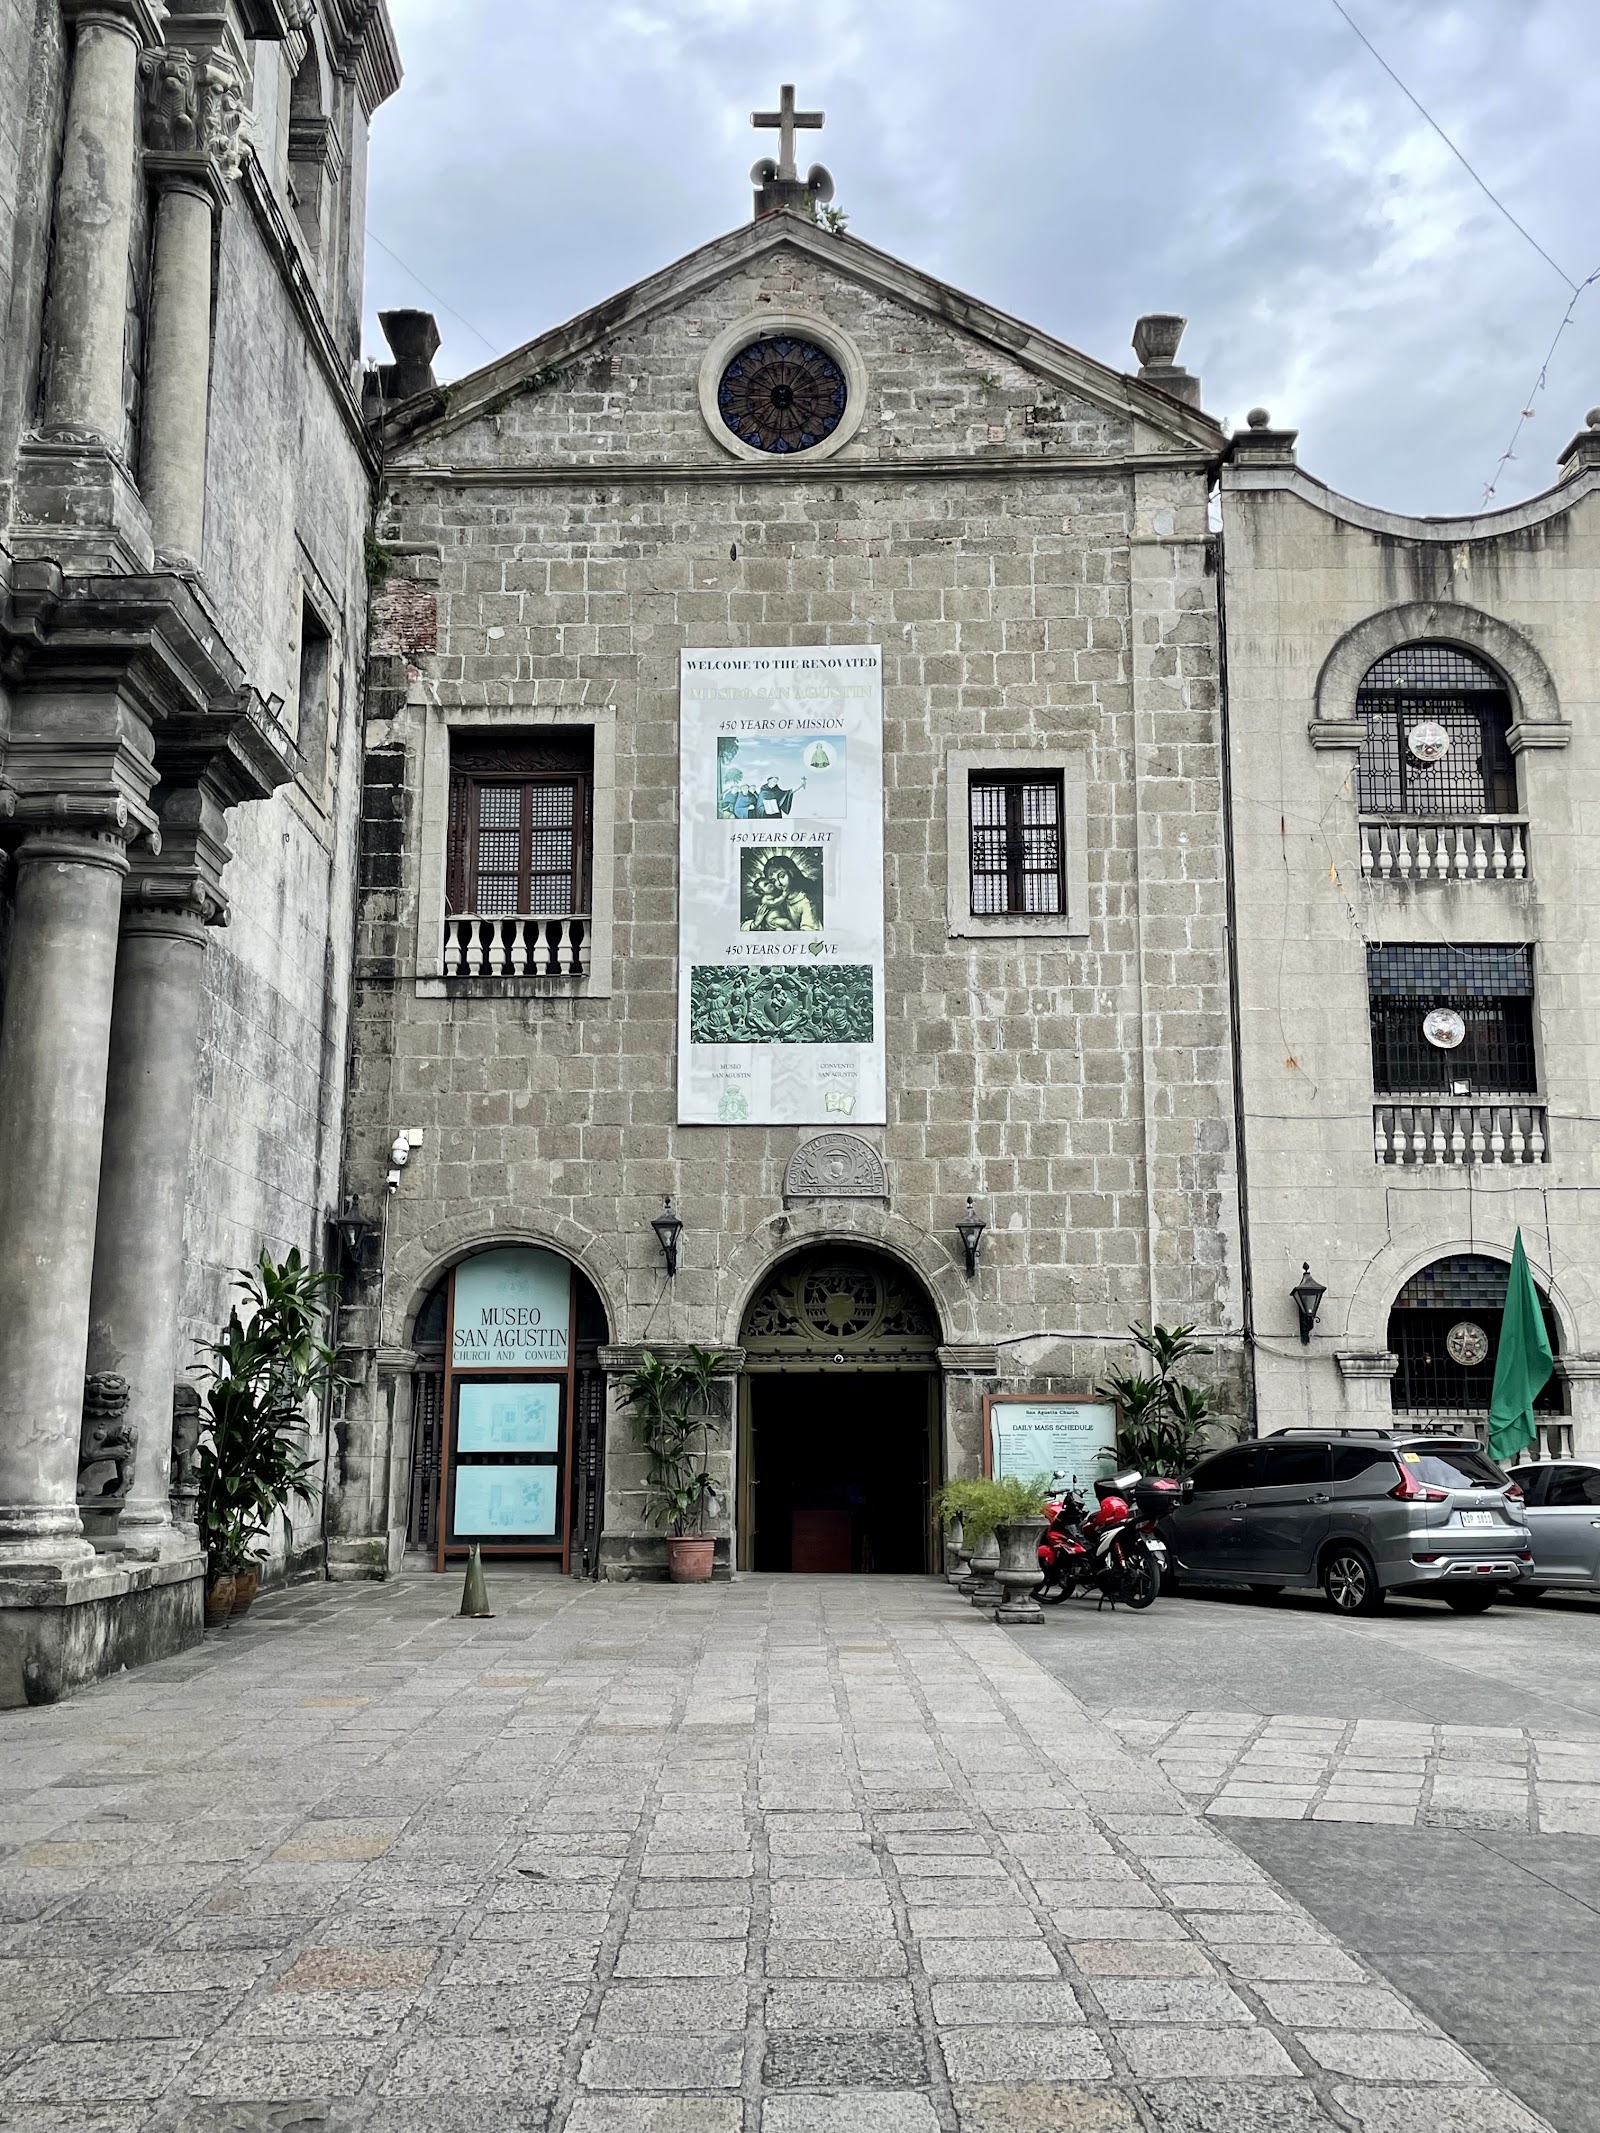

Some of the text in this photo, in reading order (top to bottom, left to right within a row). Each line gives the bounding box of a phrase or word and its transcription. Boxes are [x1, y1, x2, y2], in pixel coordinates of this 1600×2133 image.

[687, 658, 877, 670] WELCOME TO THE RENOVATED
[689, 685, 872, 700] MUSEO SAN AGUSTIN
[719, 719, 845, 730] 450 YEARS OF MISSION
[729, 832, 834, 842] 450 YEARS OF ART
[725, 940, 838, 957] 450 YEARS OF LVE
[789, 1139, 821, 1186] CONVENTO
[825, 1135, 838, 1144] DE
[481, 1308, 541, 1326] MUSEO
[454, 1329, 568, 1347] SAN AGUSTIN
[453, 1350, 568, 1361] CHURCH AND CONVENT
